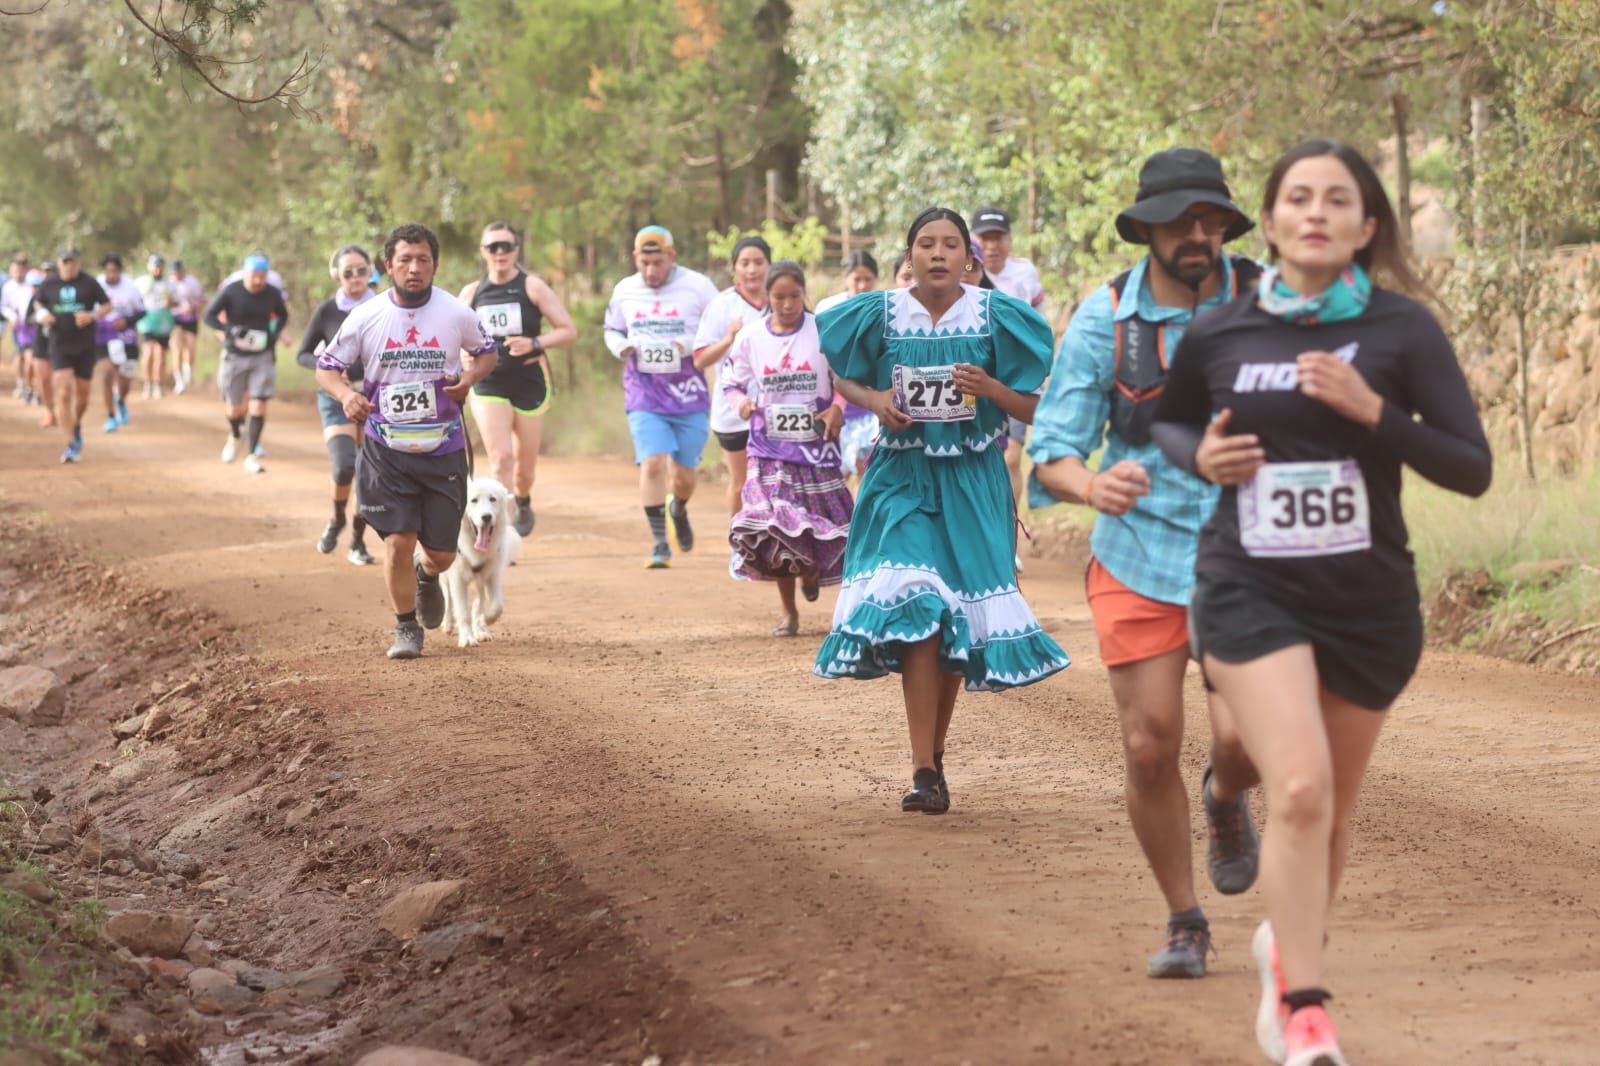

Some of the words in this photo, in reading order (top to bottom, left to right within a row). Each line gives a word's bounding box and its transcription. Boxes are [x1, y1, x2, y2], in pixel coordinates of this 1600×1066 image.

[489, 313, 508, 327] 40
[644, 349, 674, 363] 329
[1127, 320, 1139, 373] CAMP
[391, 391, 430, 413] 324
[908, 380, 963, 407] 273
[776, 414, 812, 431] 223
[1271, 486, 1355, 529] 366
